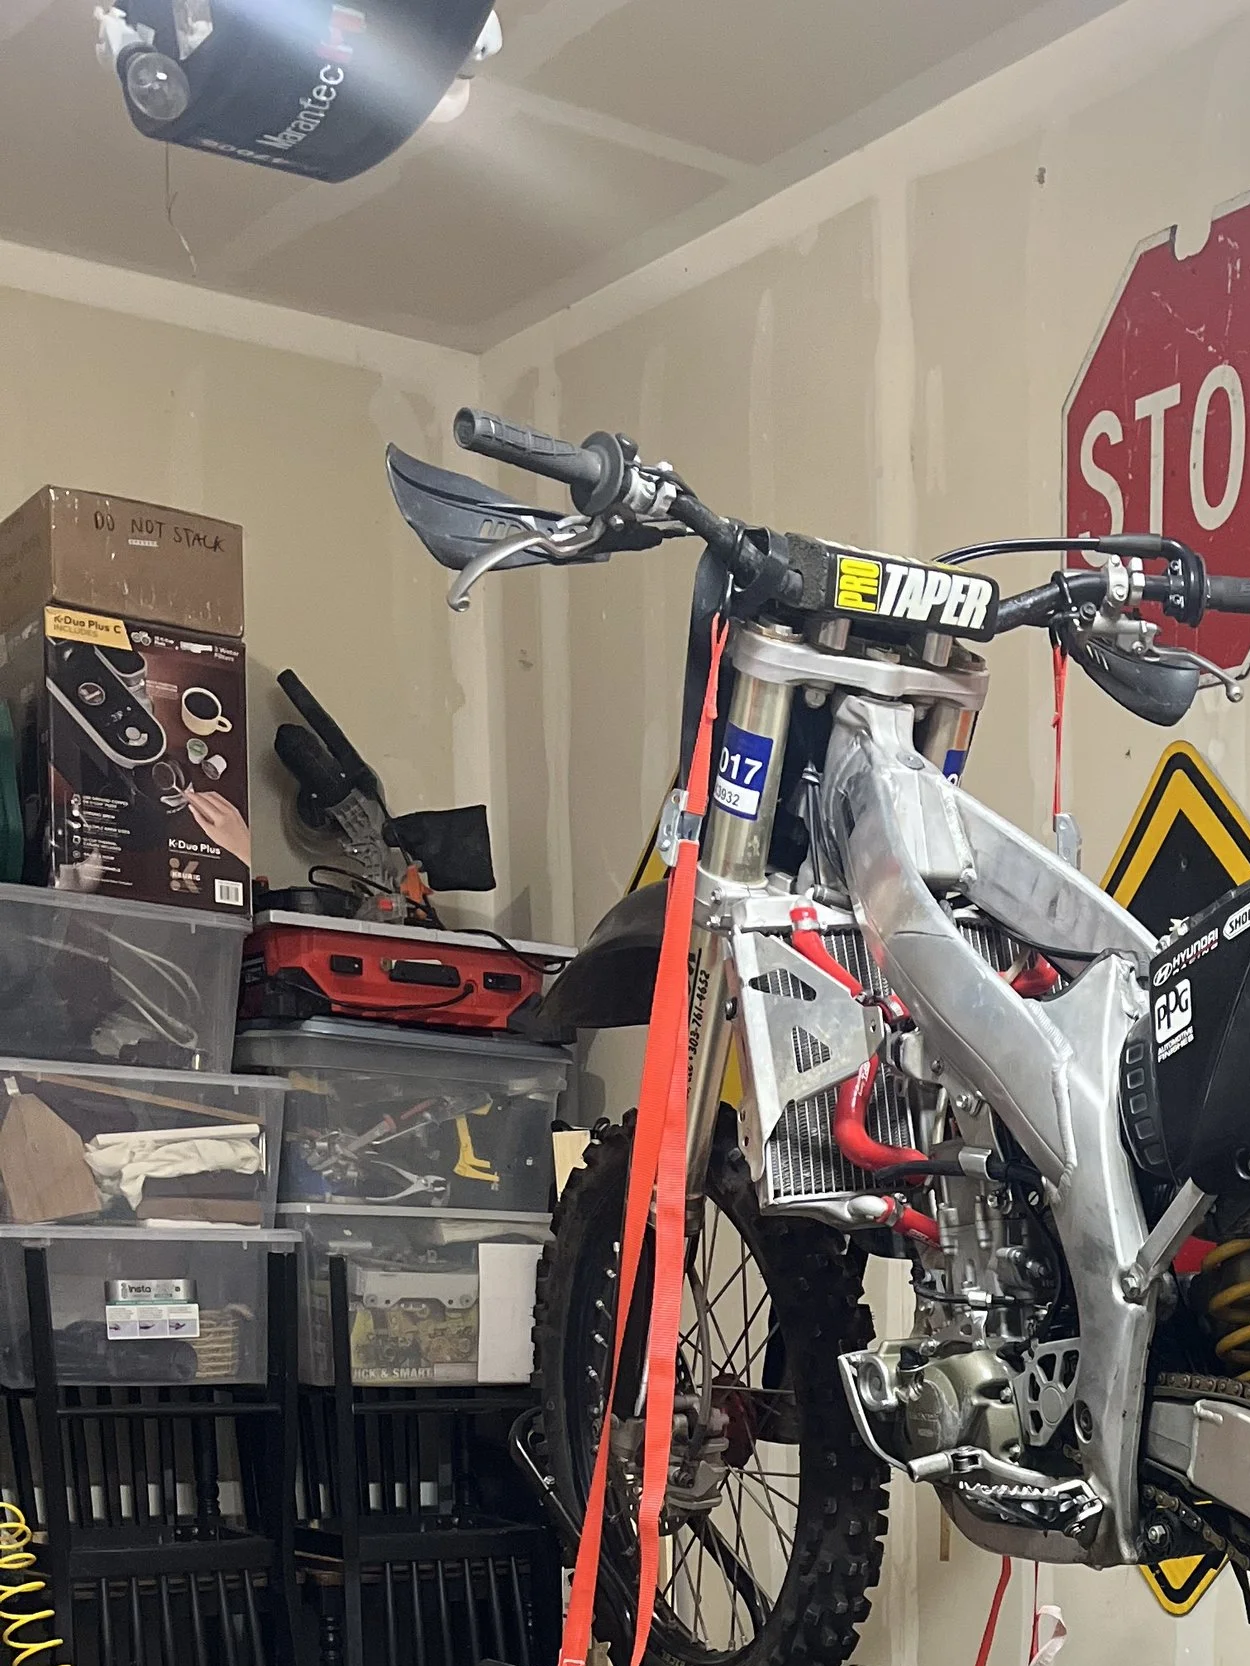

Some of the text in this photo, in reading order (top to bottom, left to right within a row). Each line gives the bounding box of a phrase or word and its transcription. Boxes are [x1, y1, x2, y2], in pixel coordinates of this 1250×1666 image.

[256, 64, 345, 150] Marantec
[94, 510, 116, 532] DO
[131, 517, 166, 539] NOT
[173, 526, 226, 553] STACK
[837, 558, 993, 630] PRO TAPER
[87, 619, 110, 633] Plus
[200, 843, 221, 855] Plus
[172, 871, 201, 881] KEURIG
[1172, 927, 1219, 970] HYUNDAI
[1172, 941, 1219, 976] RACING
[1157, 987, 1190, 1031] PPG
[392, 1367, 432, 1379] SMART
